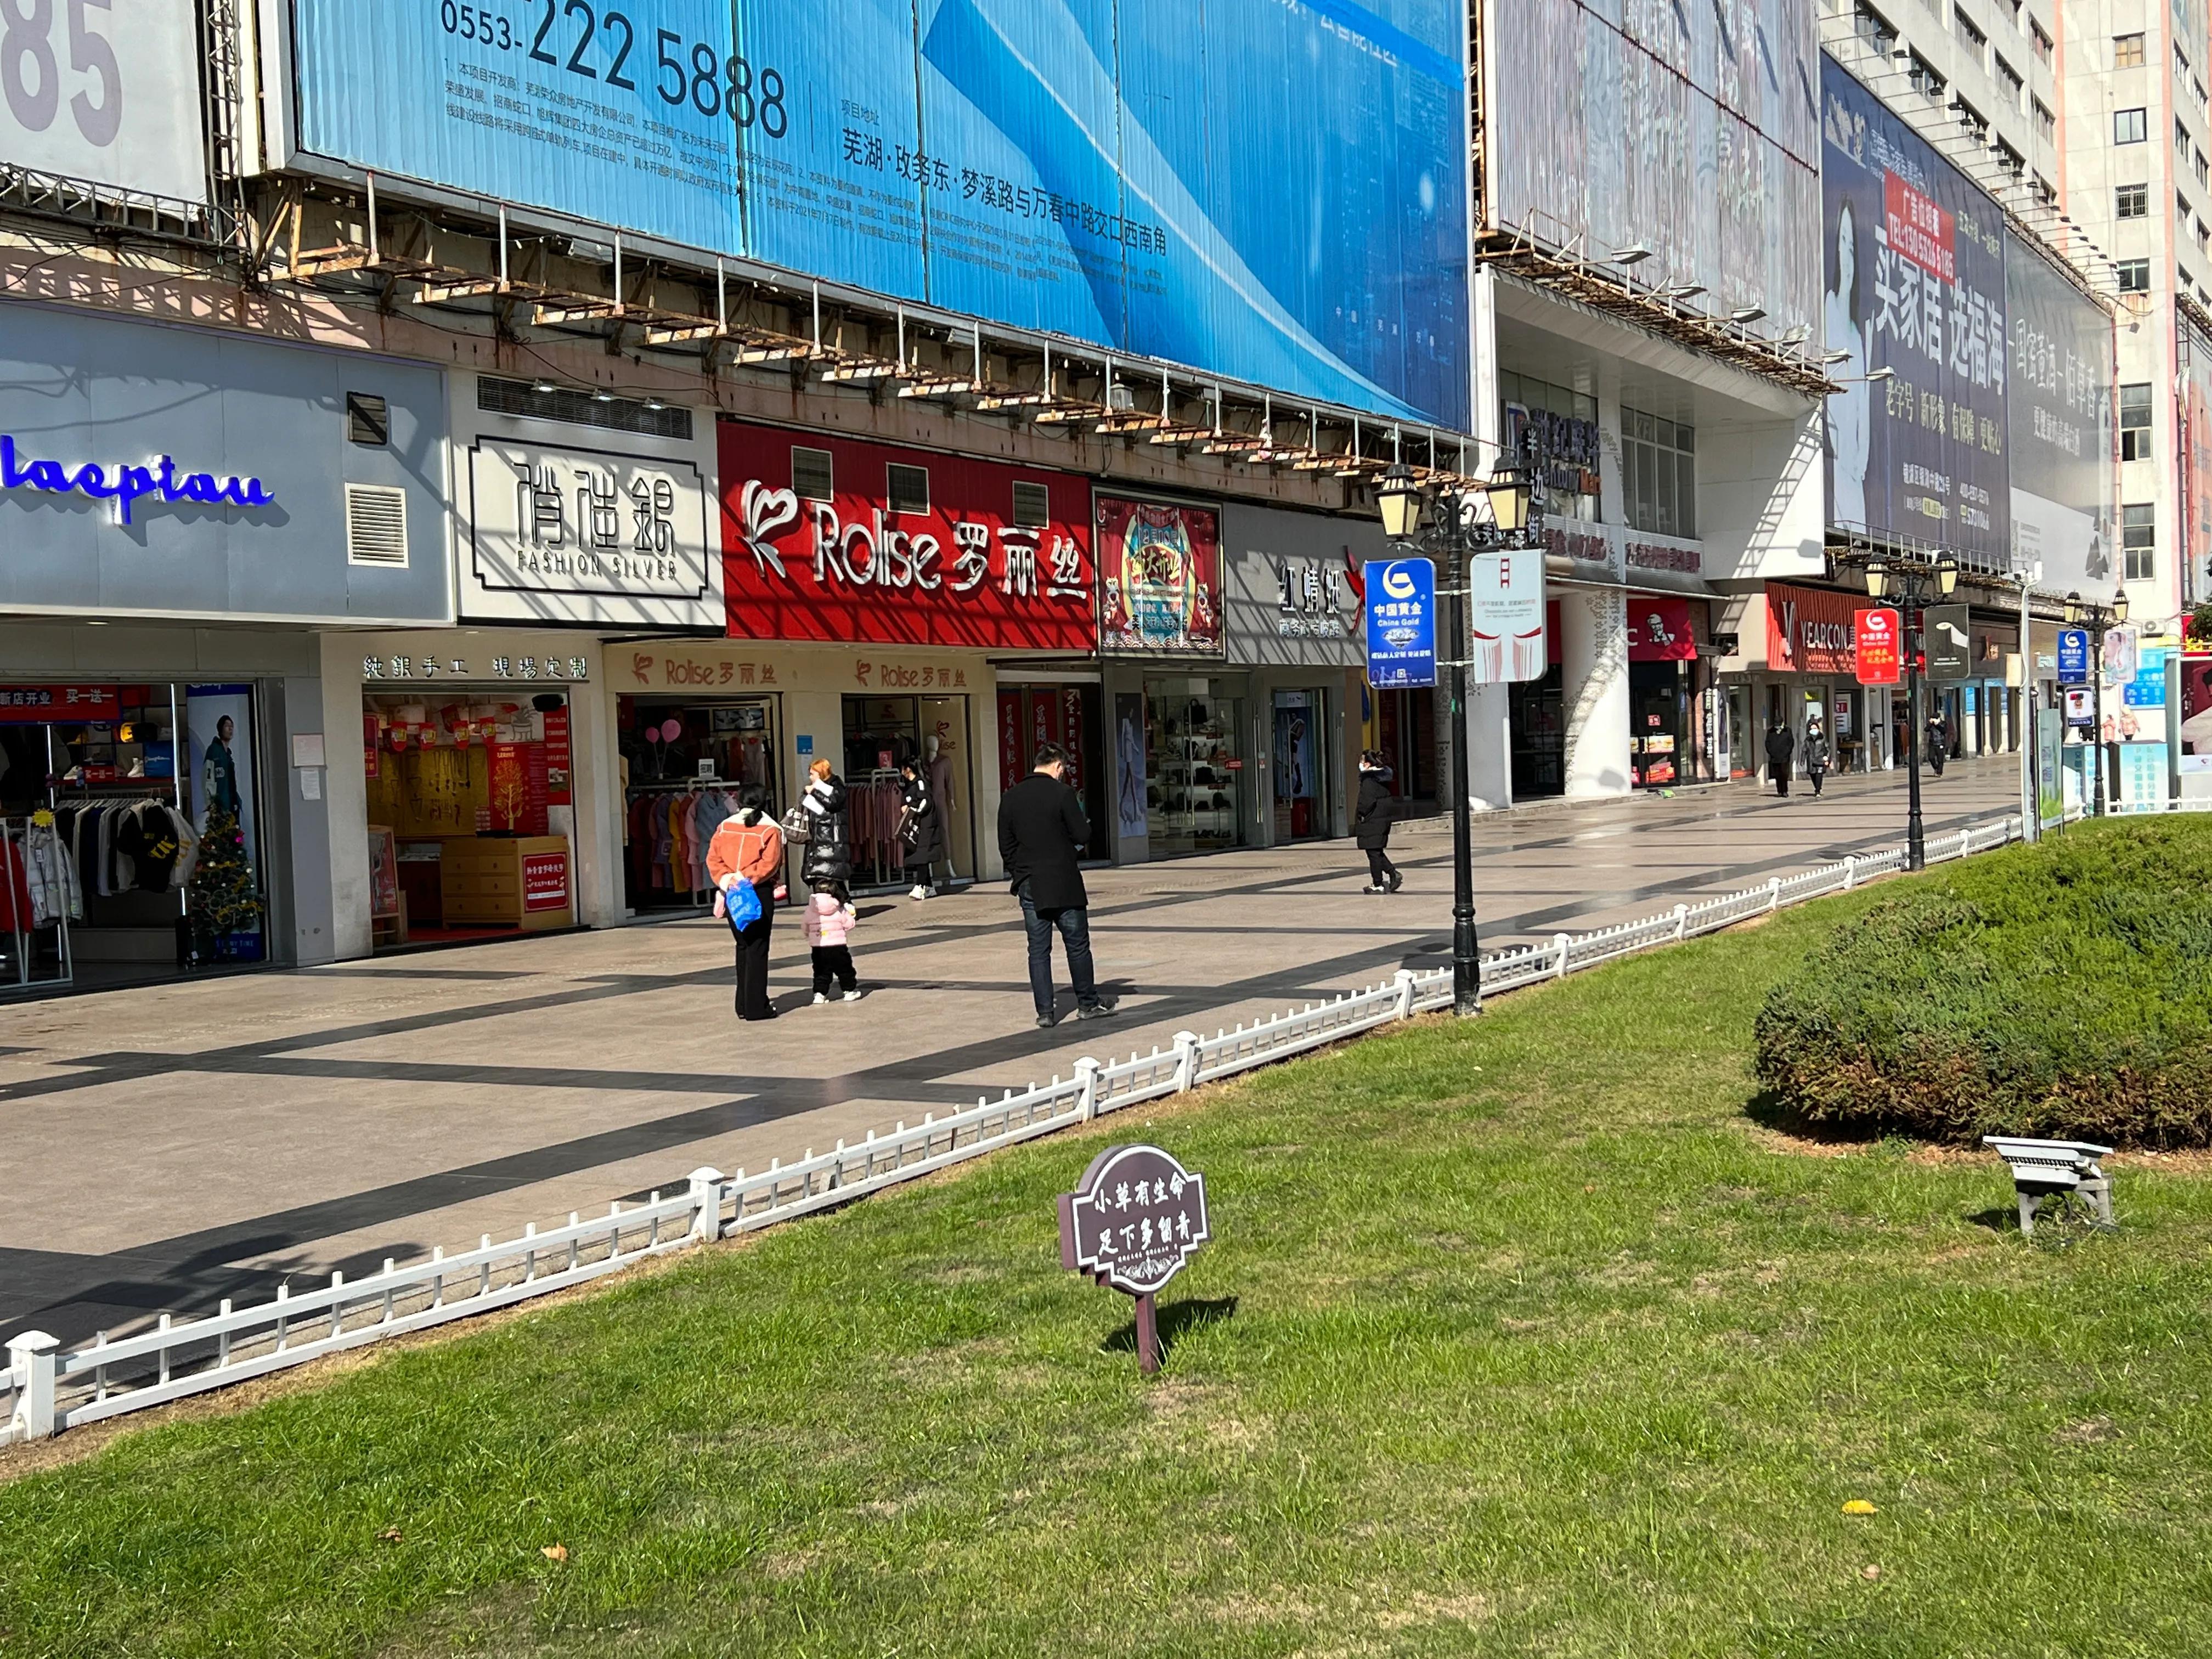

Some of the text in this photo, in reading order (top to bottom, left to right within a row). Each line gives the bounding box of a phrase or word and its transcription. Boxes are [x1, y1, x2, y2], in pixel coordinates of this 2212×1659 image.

[1886, 376, 1914, 423] 老字号
[517, 551, 676, 578] FASHION SILVER
[949, 521, 1087, 600] 罗丽丝
[1374, 601, 1422, 617] 中国黄金
[1800, 620, 1848, 650] YEARCON
[719, 662, 778, 685] 罗丽丝
[922, 667, 967, 688] 罗丽丝
[0, 689, 114, 706] 新店开业 买一送一
[1095, 1171, 1187, 1214] 小草有生命
